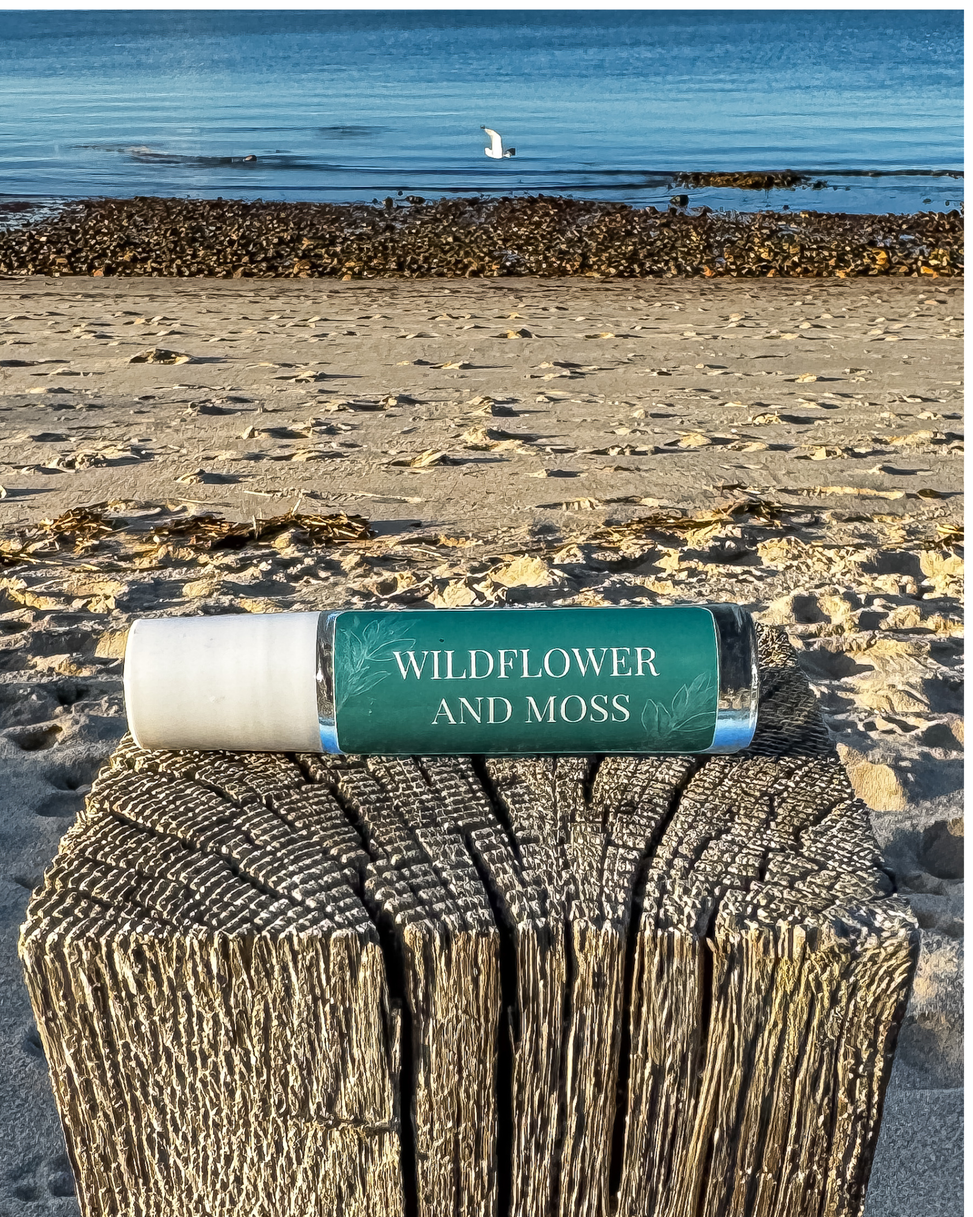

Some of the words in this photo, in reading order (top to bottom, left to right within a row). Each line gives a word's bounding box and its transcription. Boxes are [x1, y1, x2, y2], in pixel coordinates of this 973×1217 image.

[392, 646, 660, 681] WILDFLOWER
[431, 696, 513, 725] AND
[525, 694, 631, 724] MOSS
